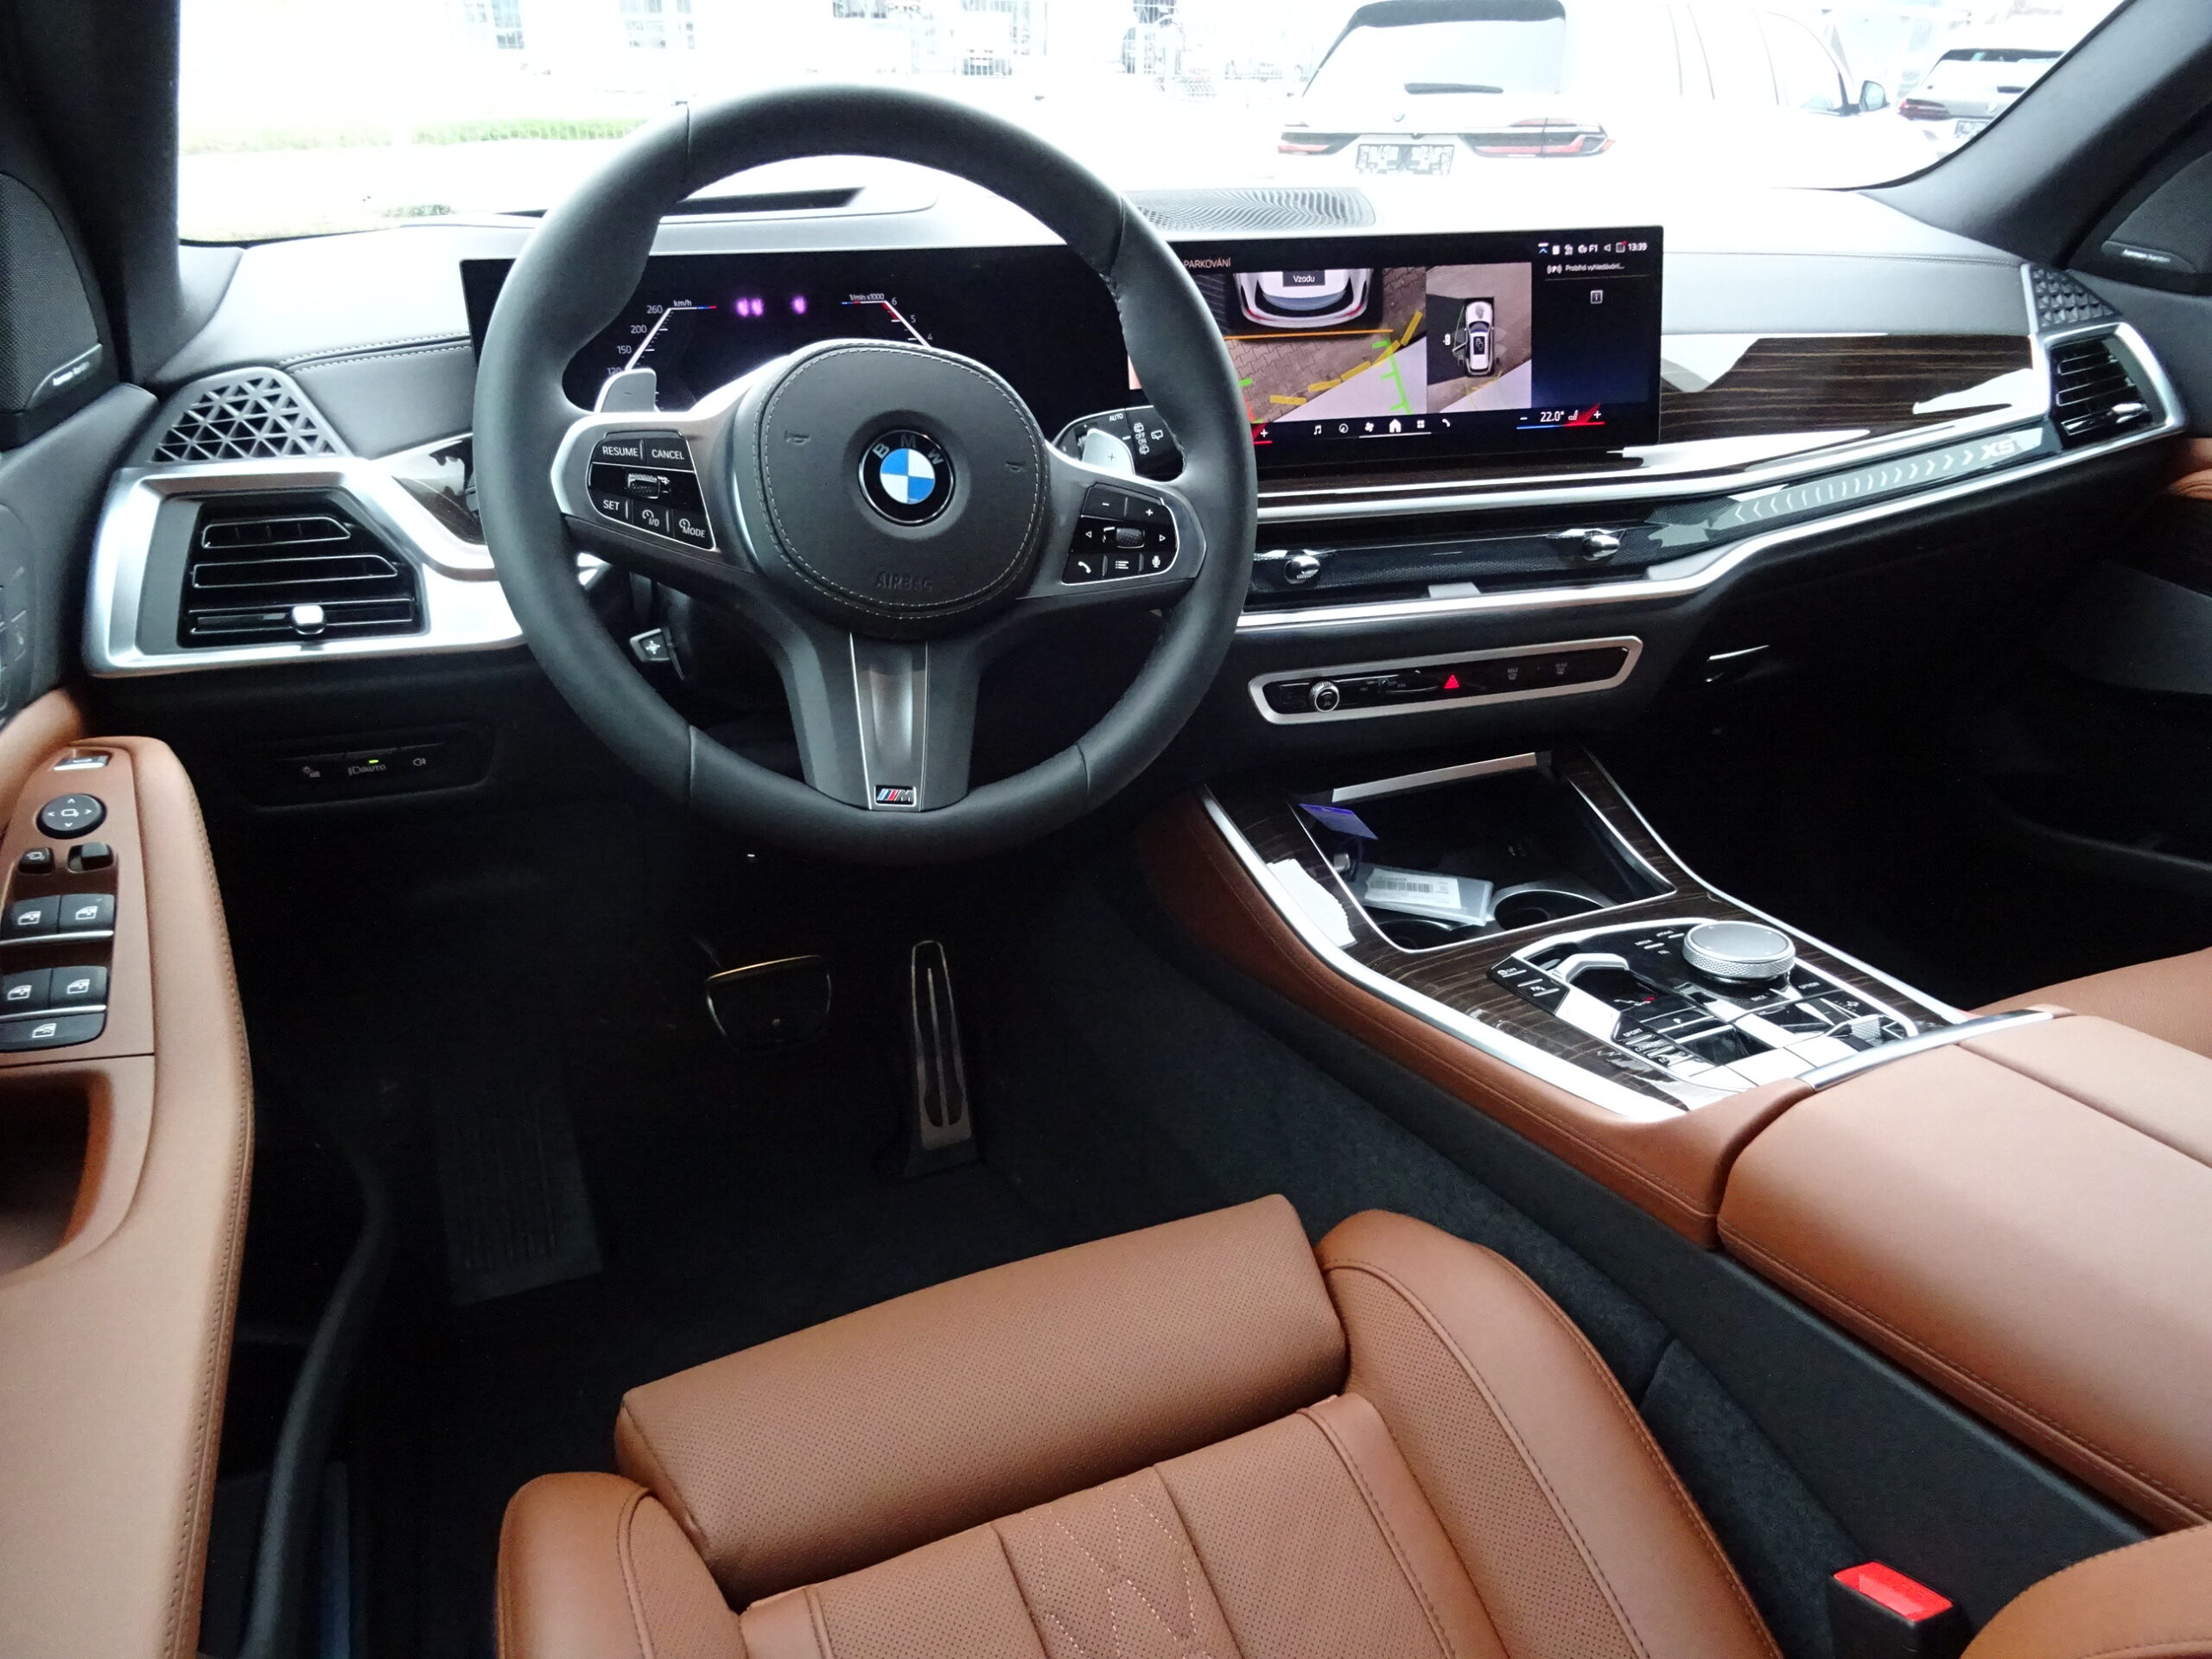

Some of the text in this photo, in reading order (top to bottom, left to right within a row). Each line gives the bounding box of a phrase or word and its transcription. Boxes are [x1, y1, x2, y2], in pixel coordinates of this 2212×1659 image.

[1183, 257, 1231, 270] PARKOVÁNÍ
[673, 299, 692, 308] km/h
[891, 296, 898, 306] 6
[646, 304, 664, 315] 260
[910, 314, 917, 323] 5
[630, 324, 647, 334] 200
[926, 333, 934, 341] 4
[616, 345, 632, 355] 150
[1109, 413, 1124, 423] AUTO
[602, 446, 685, 461] RESUME CANCEL
[872, 435, 944, 466] BMW
[603, 499, 620, 512] SET
[682, 525, 707, 538] MODE
